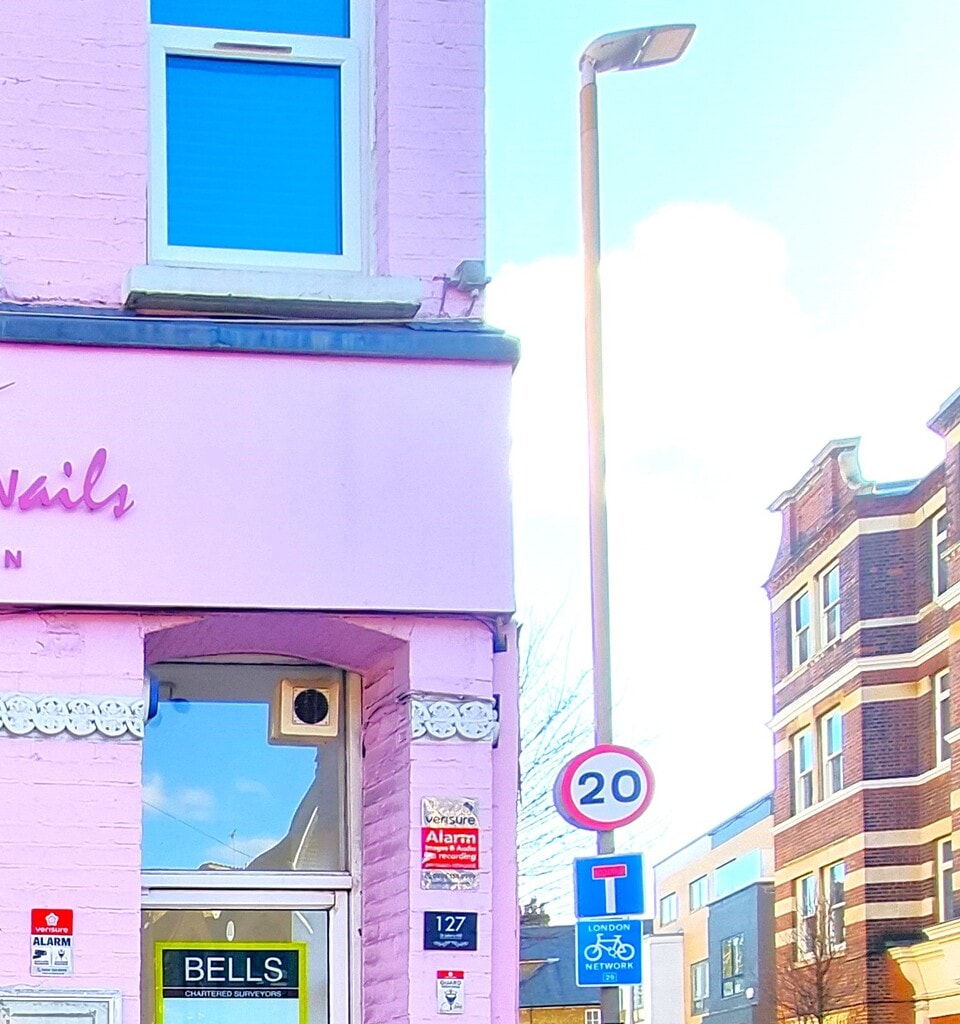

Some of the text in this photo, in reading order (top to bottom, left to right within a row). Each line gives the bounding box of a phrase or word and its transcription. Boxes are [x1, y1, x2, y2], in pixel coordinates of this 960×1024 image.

[577, 768, 642, 806] 20
[425, 830, 476, 844] Alarm
[438, 853, 477, 863] recording
[436, 915, 467, 932] 127
[588, 923, 631, 932] LONDON
[35, 926, 69, 934] verisure
[33, 936, 71, 947] ALARM
[184, 956, 284, 983] BELLS
[585, 961, 634, 971] NETWORK
[184, 990, 282, 998] CHARTERED SURVEYORS
